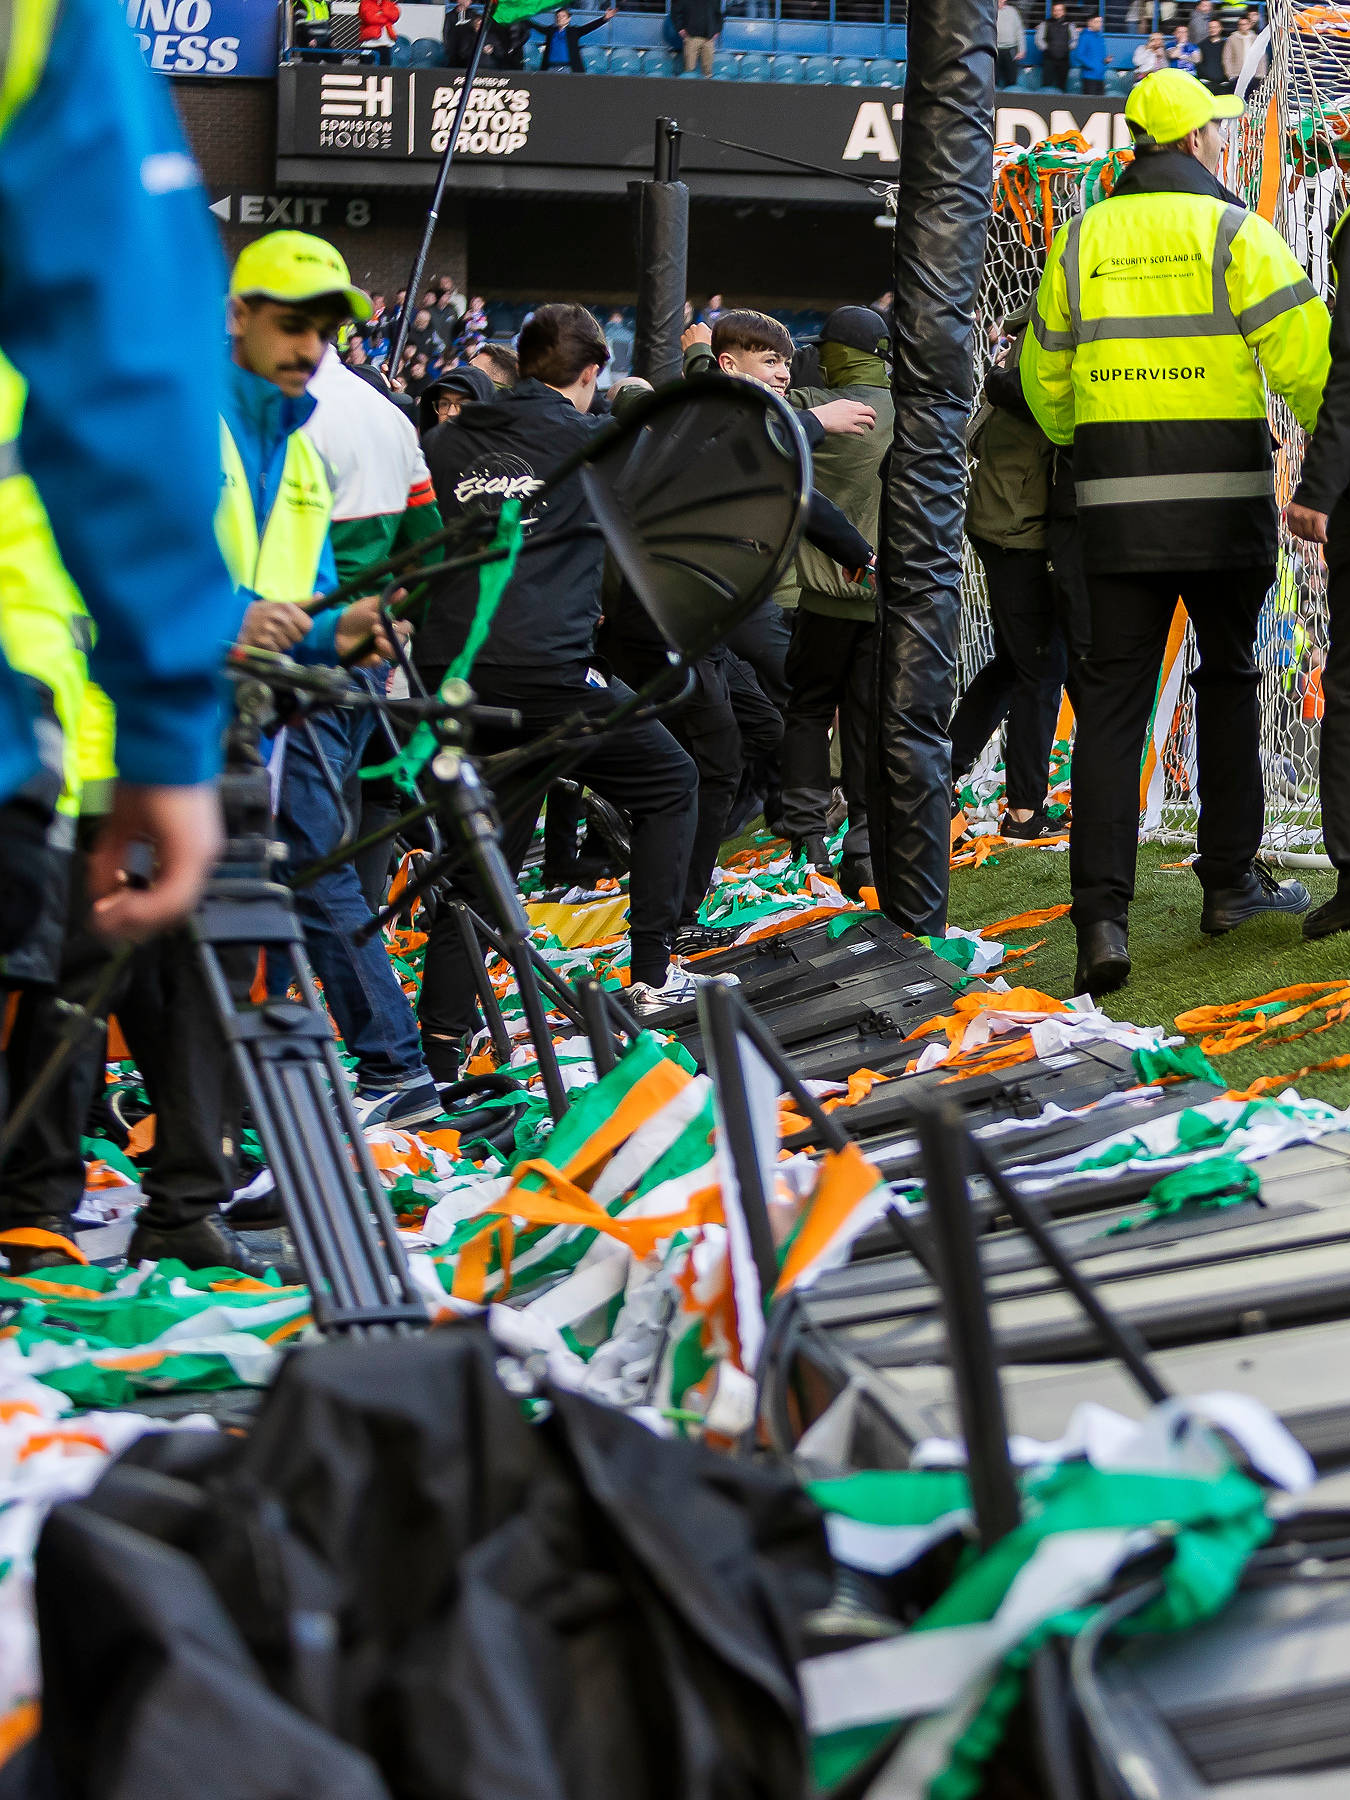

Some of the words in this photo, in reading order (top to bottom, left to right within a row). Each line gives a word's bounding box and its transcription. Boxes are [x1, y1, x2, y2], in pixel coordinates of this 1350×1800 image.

[125, 0, 212, 33] INO
[320, 119, 393, 133] EDMISTON
[431, 109, 533, 133] MOTOR
[430, 131, 528, 155] GROUP
[239, 194, 329, 226] EXIT
[345, 198, 372, 229] 8
[1111, 256, 1148, 266] SECURITY
[1149, 254, 1190, 265] SCOTLAND
[1190, 252, 1203, 262] LTD
[1089, 366, 1206, 383] SUPERVISOR
